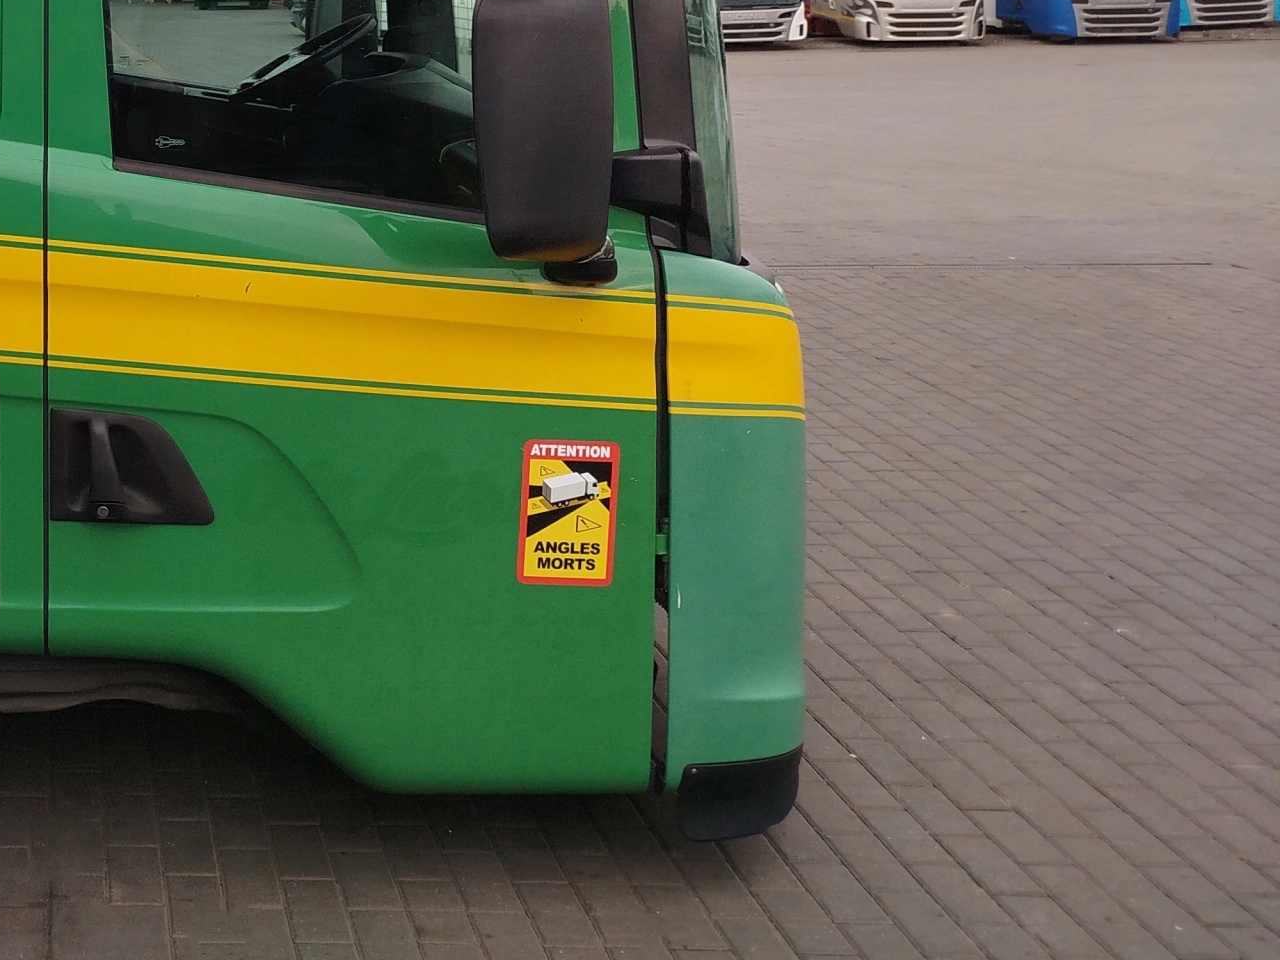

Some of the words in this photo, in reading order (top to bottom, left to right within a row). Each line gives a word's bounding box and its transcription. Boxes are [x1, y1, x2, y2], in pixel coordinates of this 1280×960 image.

[727, 12, 768, 21] SCANIA
[530, 443, 611, 458] ATTENTION
[533, 541, 601, 555] ANGLES
[537, 557, 596, 570] MORTS
